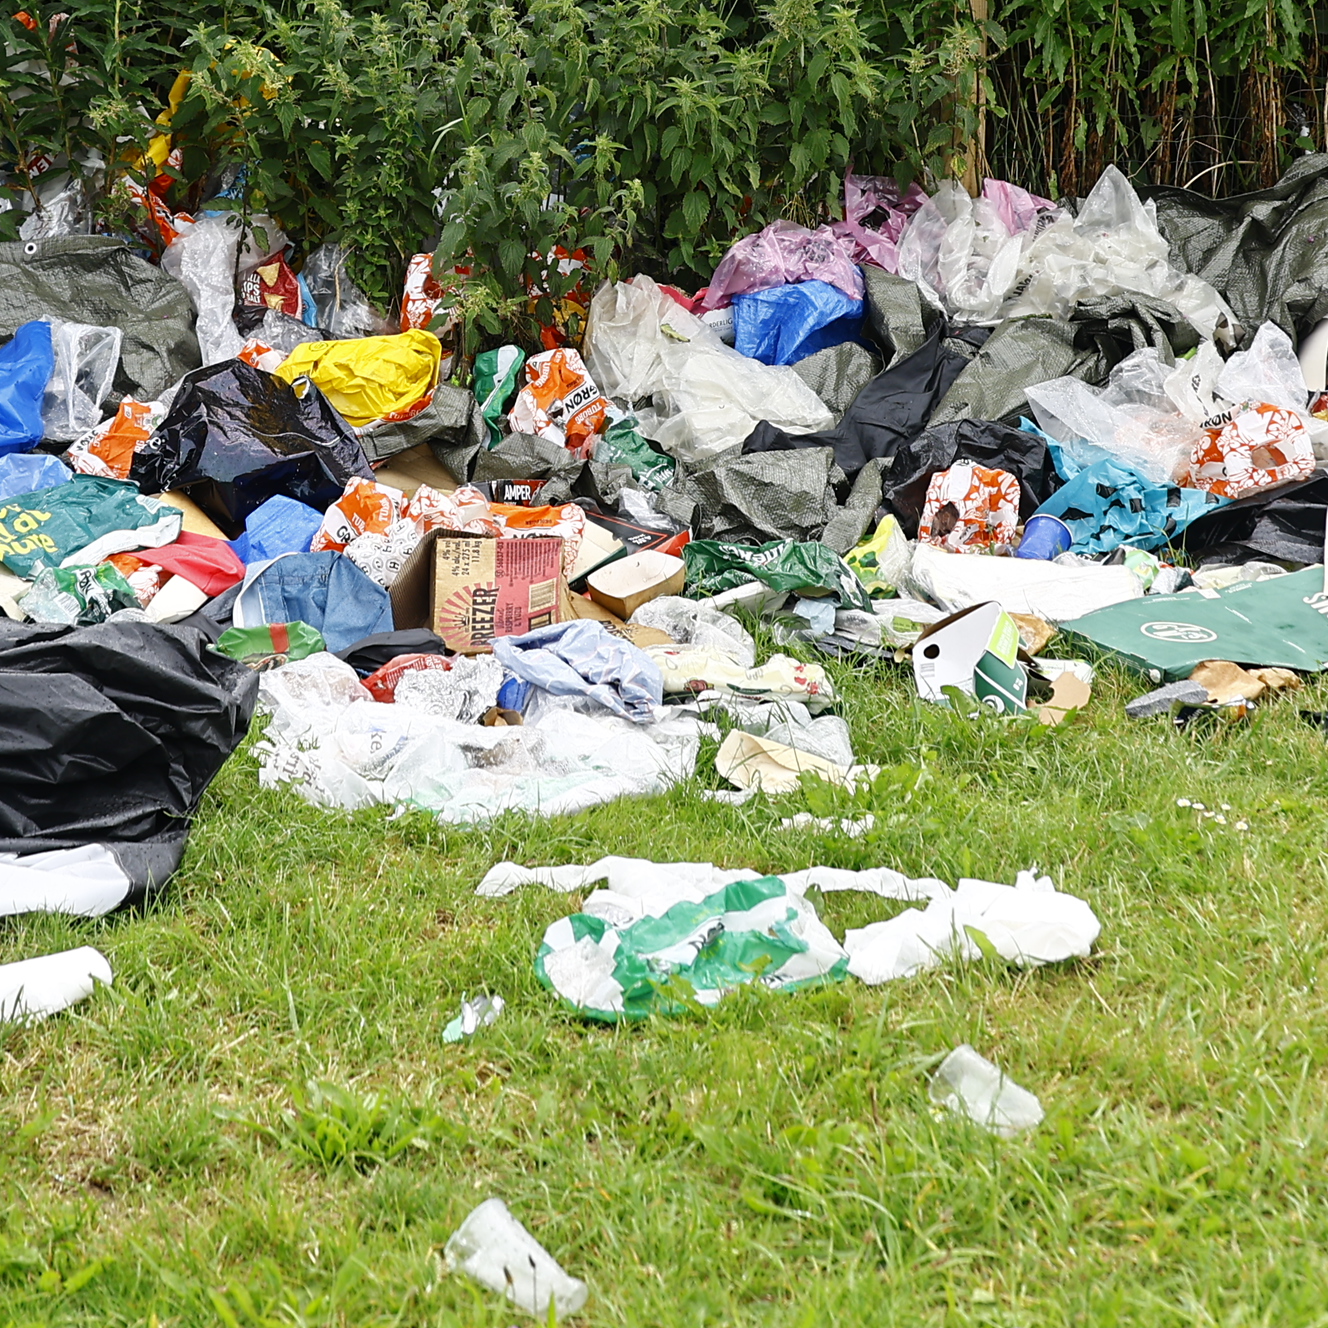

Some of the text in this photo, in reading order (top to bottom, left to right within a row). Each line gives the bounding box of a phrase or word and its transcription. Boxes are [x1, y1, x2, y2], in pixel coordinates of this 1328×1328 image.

[504, 484, 531, 501] AMPER
[471, 540, 482, 552] kg
[461, 548, 471, 561] 275
[389, 561, 400, 570] H
[461, 567, 470, 576] 24
